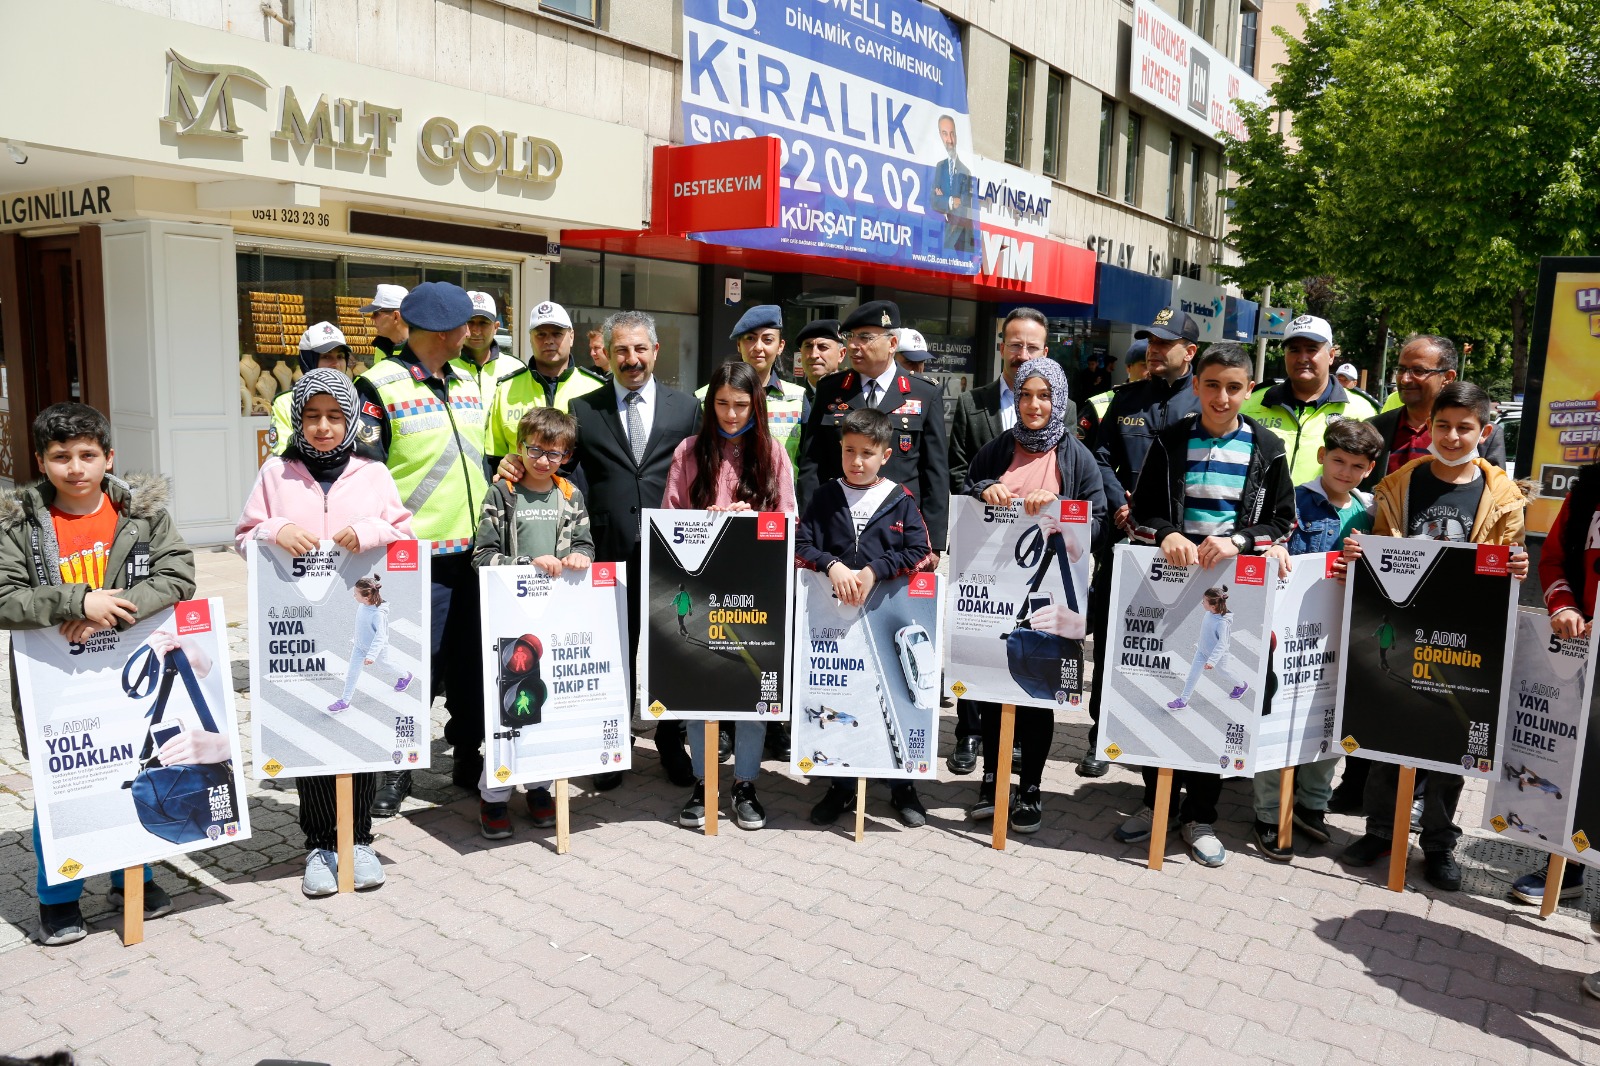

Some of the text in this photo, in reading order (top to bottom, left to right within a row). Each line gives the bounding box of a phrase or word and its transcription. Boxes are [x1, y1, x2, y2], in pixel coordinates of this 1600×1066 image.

[892, 13, 955, 61] BANKER
[270, 86, 563, 183] MLT GOLD
[824, 148, 925, 215] 02 02
[252, 209, 330, 228] 0541 323 23 36
[781, 203, 912, 247] KÜRŞAT BATUR
[946, 344, 972, 354] BANKER
[1550, 400, 1597, 408] TÜM ÜRÜNLER
[516, 509, 540, 517] SLOW
[984, 506, 994, 522] 5
[673, 527, 684, 544] 5
[1382, 548, 1411, 556] YAYALAR
[292, 558, 306, 577] 5
[1380, 555, 1392, 572] 5
[970, 574, 996, 586] ADIM
[1150, 564, 1162, 582] 5
[516, 580, 528, 598] 5
[958, 584, 989, 600] YOLA
[709, 594, 754, 608] 2. ADIM
[958, 599, 1014, 616] ODAKLAN
[268, 606, 313, 618] 4. ADIM
[709, 608, 768, 624] GÖRÜNÜR
[1126, 606, 1164, 620] 4. ADIM
[268, 620, 304, 636] YAYA
[708, 625, 726, 640] OL
[812, 628, 846, 639] 1. ADIM
[1125, 618, 1155, 634] YAYA
[1284, 622, 1322, 639] 3. ADIM
[551, 632, 593, 648] 3. ADIM
[811, 640, 838, 653] YAYA
[1415, 629, 1467, 648] 2. ADIM
[1548, 634, 1562, 654] 5
[810, 657, 864, 671] YOLUNDA
[1061, 658, 1078, 667] 7-13
[1121, 652, 1170, 670] KULLAN
[1283, 651, 1336, 672] IŞIKLARINI
[1414, 646, 1482, 669] GÖRÜNÜR
[270, 658, 326, 674] KULLAN
[552, 660, 610, 680] IŞIKLARINI
[1412, 662, 1432, 680] OL
[809, 671, 848, 686] İLERLE
[1313, 668, 1325, 682] ET
[587, 678, 600, 693] ET
[1521, 680, 1560, 700] 1. ADIM
[1519, 693, 1549, 714] YAYA
[44, 716, 100, 738] 5. ADIM
[395, 716, 414, 725] 7-13
[603, 719, 618, 728] 7-13
[1226, 723, 1244, 732] 7-13
[1470, 721, 1489, 732] 7-13
[1516, 710, 1577, 740] YOLUNDA
[396, 730, 414, 738] 2022
[909, 729, 925, 737] 7-13
[1468, 737, 1488, 745] 2022
[1469, 730, 1489, 738] MAYIS
[1512, 726, 1556, 753] İLERLE
[46, 733, 93, 755] YOLA
[48, 744, 133, 773] ODAKLAN
[207, 784, 229, 796] 7-13
[209, 793, 230, 804] MAYIS
[210, 800, 230, 810] 2022
